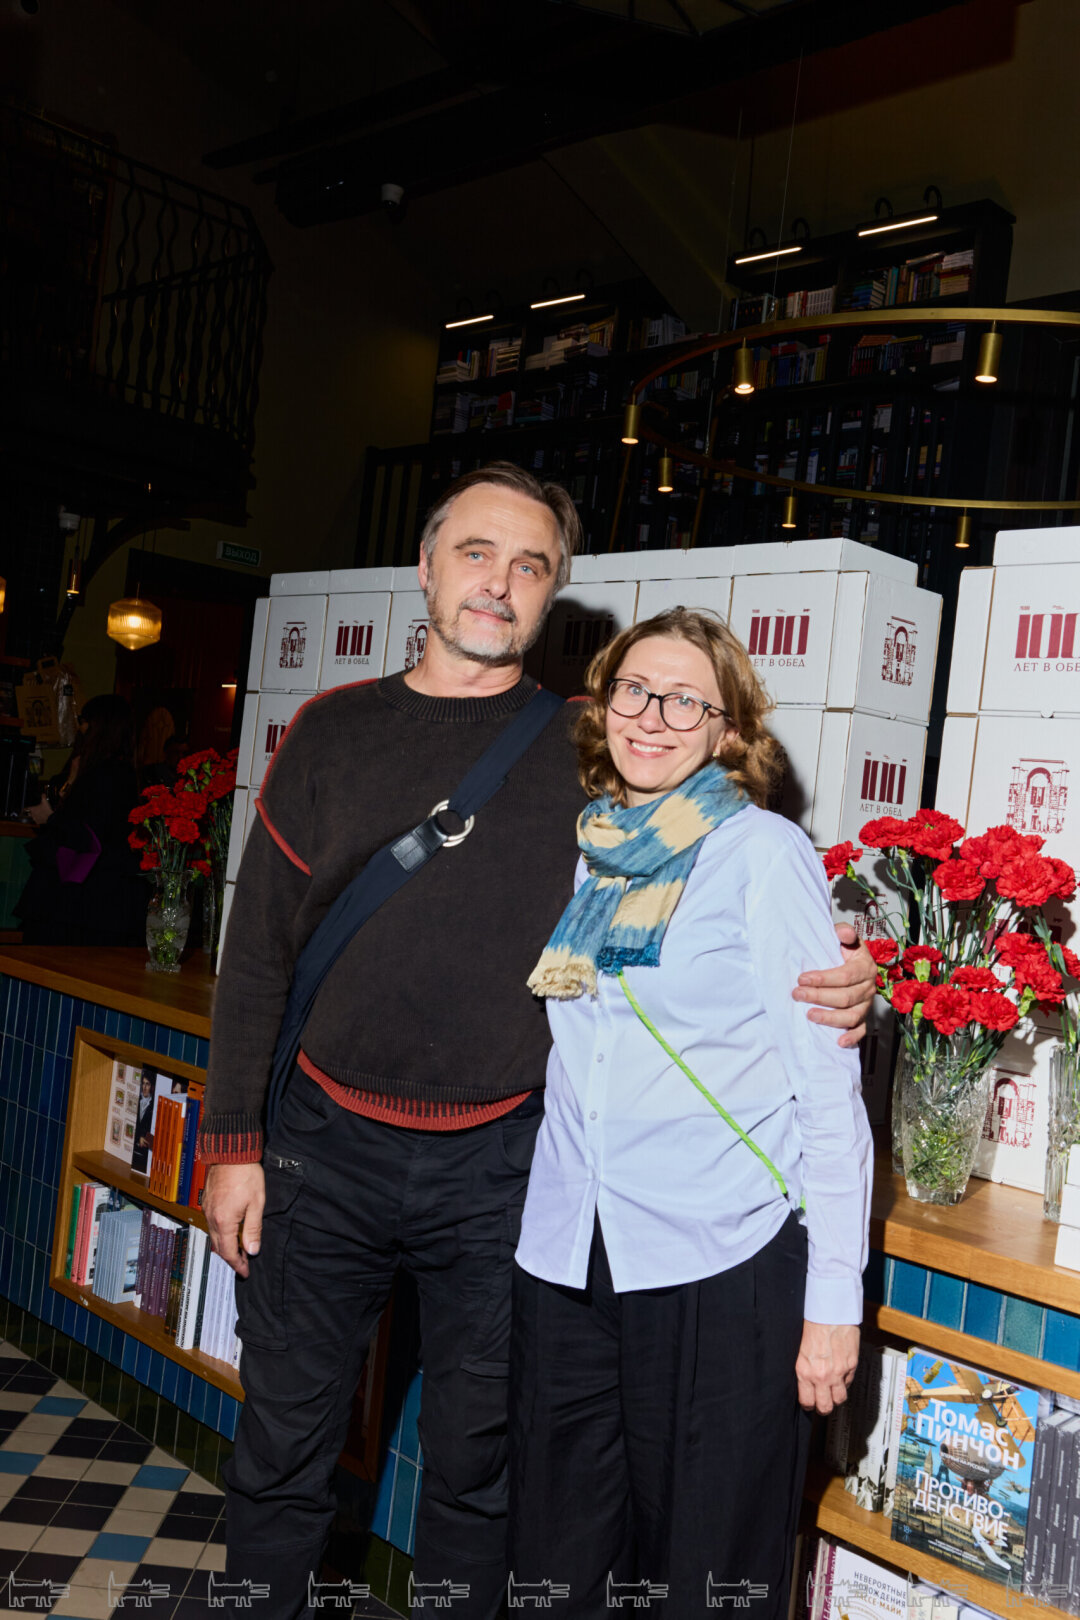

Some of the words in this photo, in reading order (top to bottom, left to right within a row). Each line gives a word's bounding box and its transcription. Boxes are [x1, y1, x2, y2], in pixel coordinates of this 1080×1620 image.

[224, 546, 257, 563] ВЫХОД
[335, 624, 374, 657] 100
[748, 615, 810, 656] 100
[334, 657, 347, 665] ЛЕТ
[347, 657, 352, 665] В
[353, 656, 370, 665] ОБЕД
[753, 658, 767, 667] ЕТ
[769, 658, 775, 667] В
[778, 658, 805, 668] ОБЕД
[1014, 662, 1039, 673] ЛЕТ
[1043, 662, 1051, 672] В
[860, 758, 907, 805] 100
[860, 803, 875, 813] ЛЕТ
[876, 804, 881, 814] В
[882, 806, 902, 817] ОБЕД
[930, 1397, 1010, 1448] Томас
[915, 1412, 1020, 1471] Пинчон
[915, 1469, 1011, 1520] ПРОТИВО-
[912, 1487, 1010, 1541] ДЕНСТВИЕ
[853, 1571, 907, 1600] НЕВЕРОЯТНЫЕ
[853, 1580, 906, 1609] ПОХОЖДЕНИЯ
